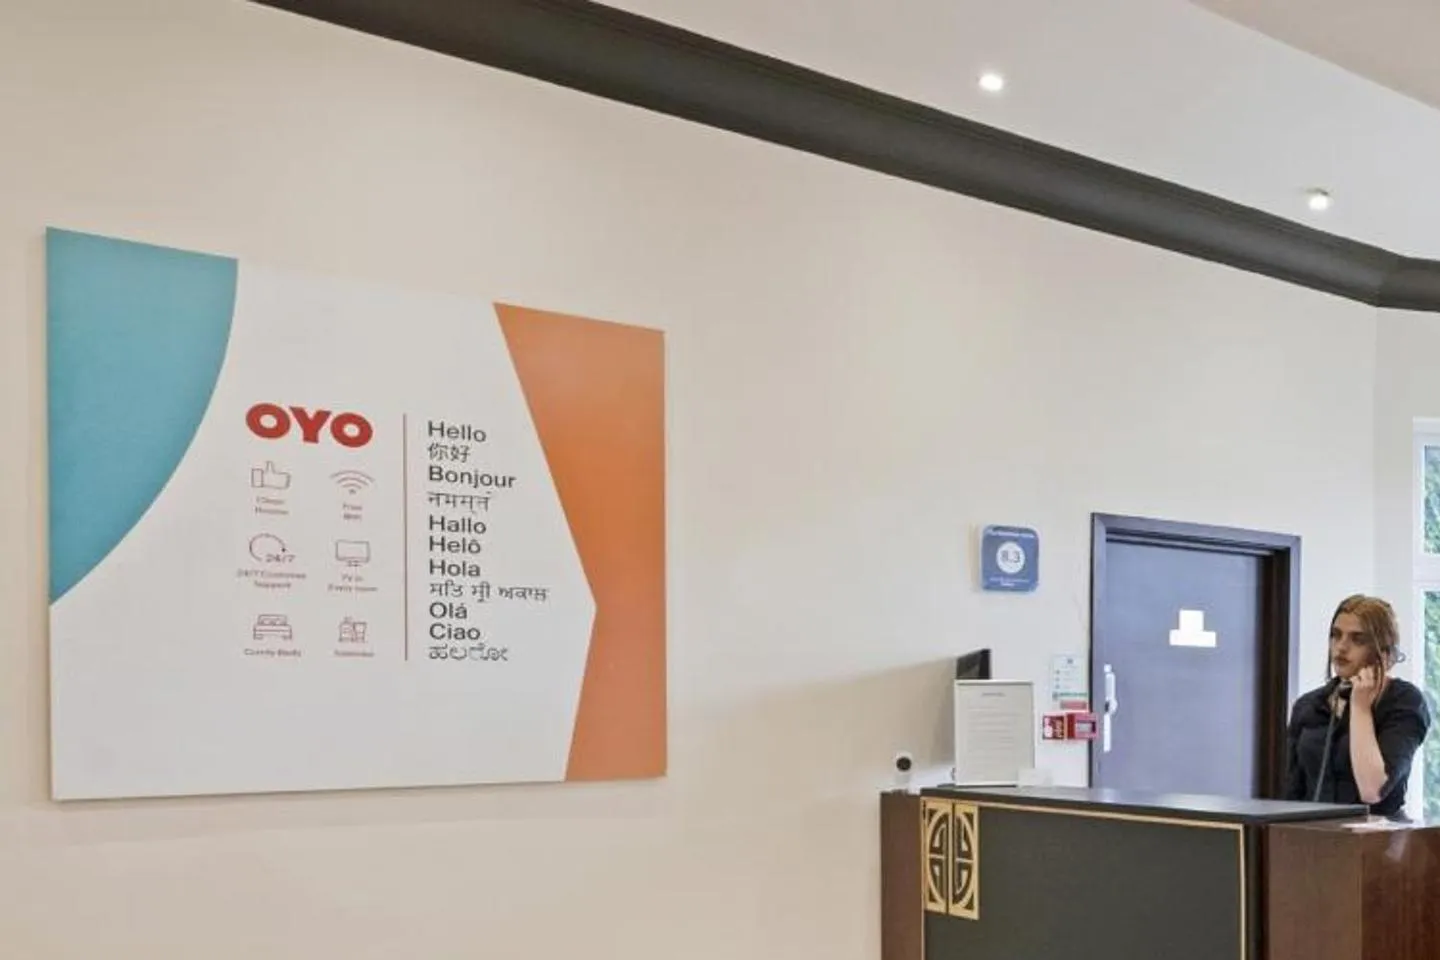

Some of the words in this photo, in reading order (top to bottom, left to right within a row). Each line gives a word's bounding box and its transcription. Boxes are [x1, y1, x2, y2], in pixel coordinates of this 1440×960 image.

[246, 403, 373, 448] OYO
[428, 420, 487, 442] Hello
[427, 442, 471, 463] 你好
[428, 465, 517, 489] Bonjour
[429, 514, 487, 534] Hallo
[429, 558, 481, 577] Hola
[429, 602, 468, 619] Olá
[429, 622, 481, 640] Ciao
